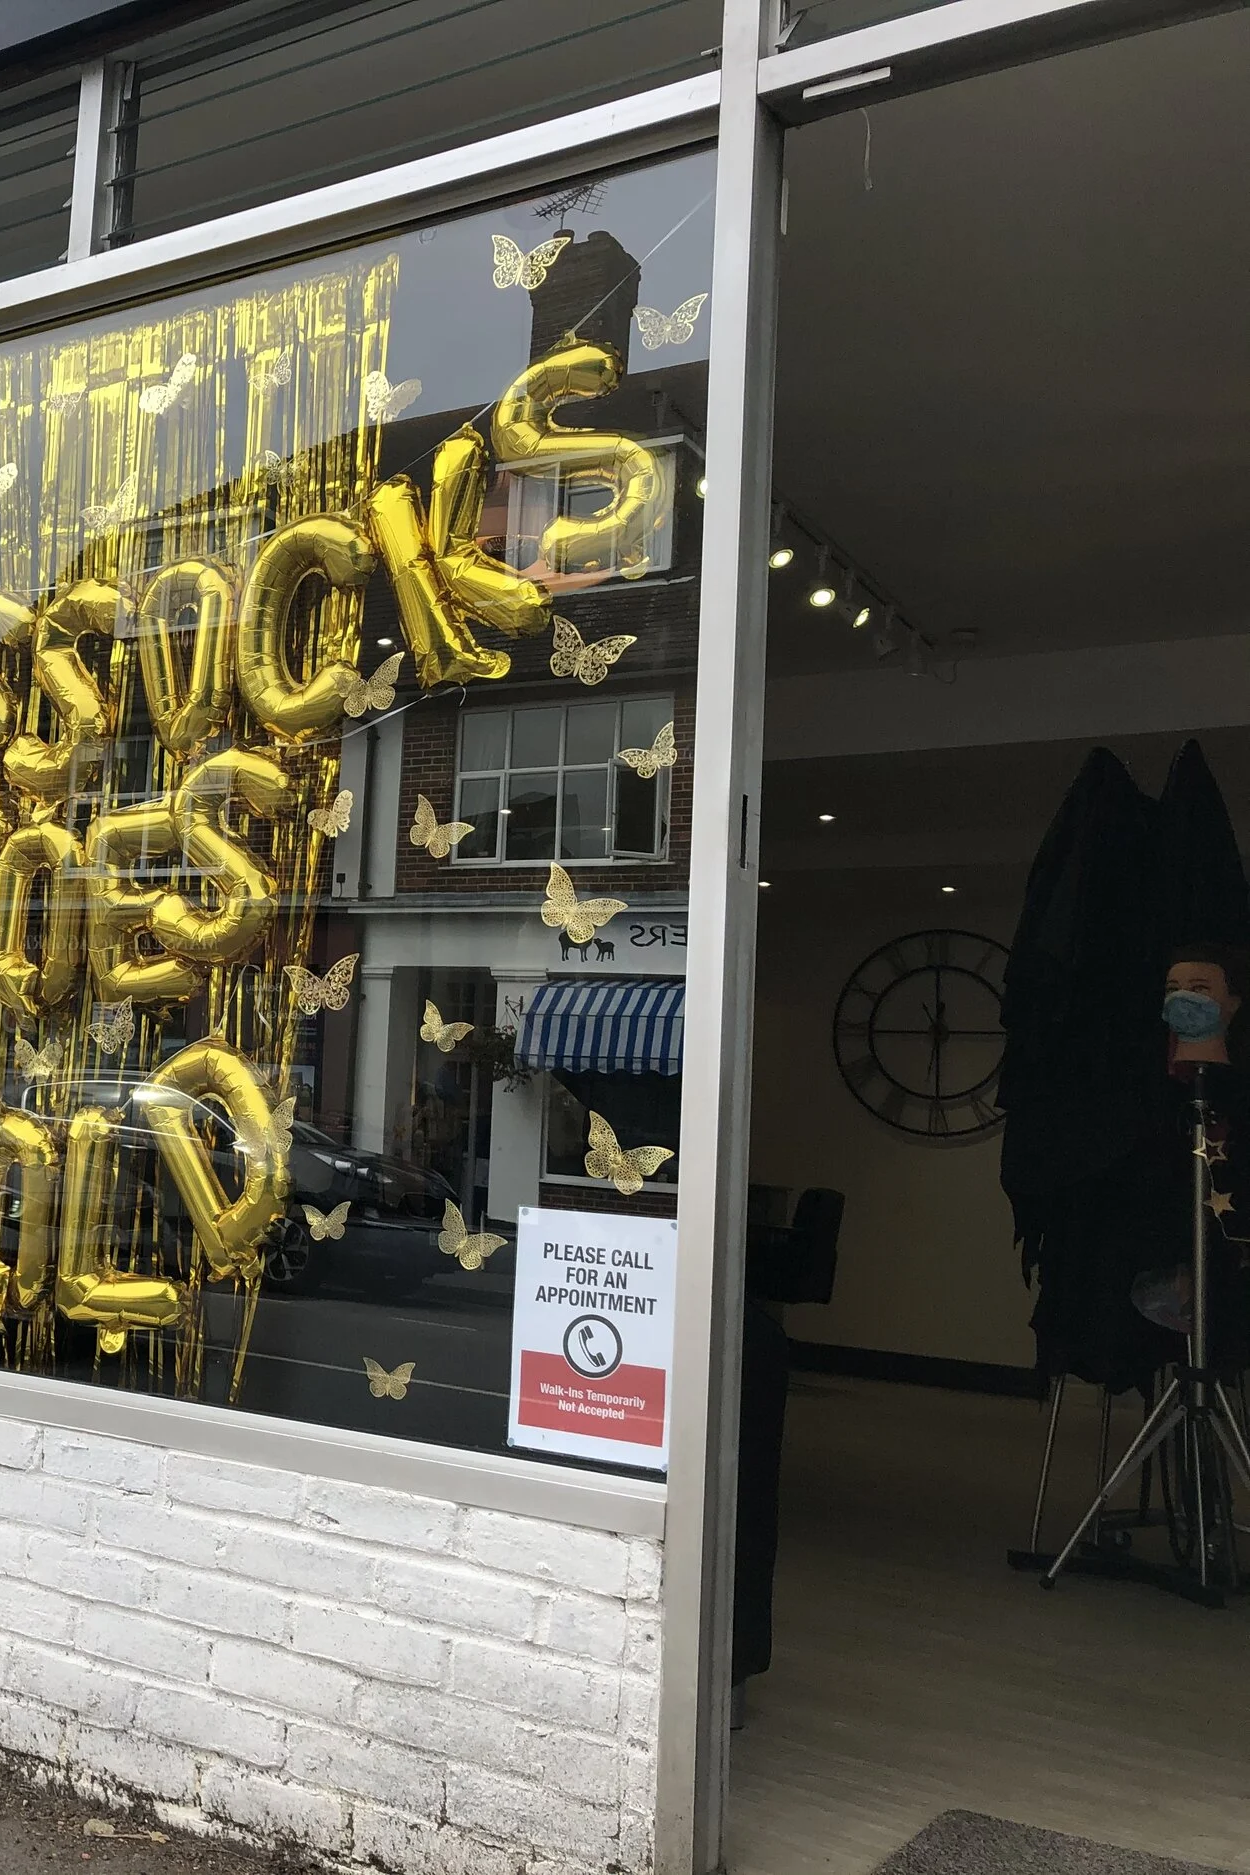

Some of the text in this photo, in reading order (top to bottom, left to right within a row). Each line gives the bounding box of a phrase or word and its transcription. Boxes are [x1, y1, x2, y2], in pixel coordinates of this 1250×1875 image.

[543, 1242, 654, 1270] PLEASE CALL
[565, 1266, 628, 1290] FOR AN
[535, 1285, 658, 1315] APPOINTMENT
[540, 1382, 646, 1411] Walk-Ins Temporarily
[558, 1399, 625, 1420] Not Accepted
